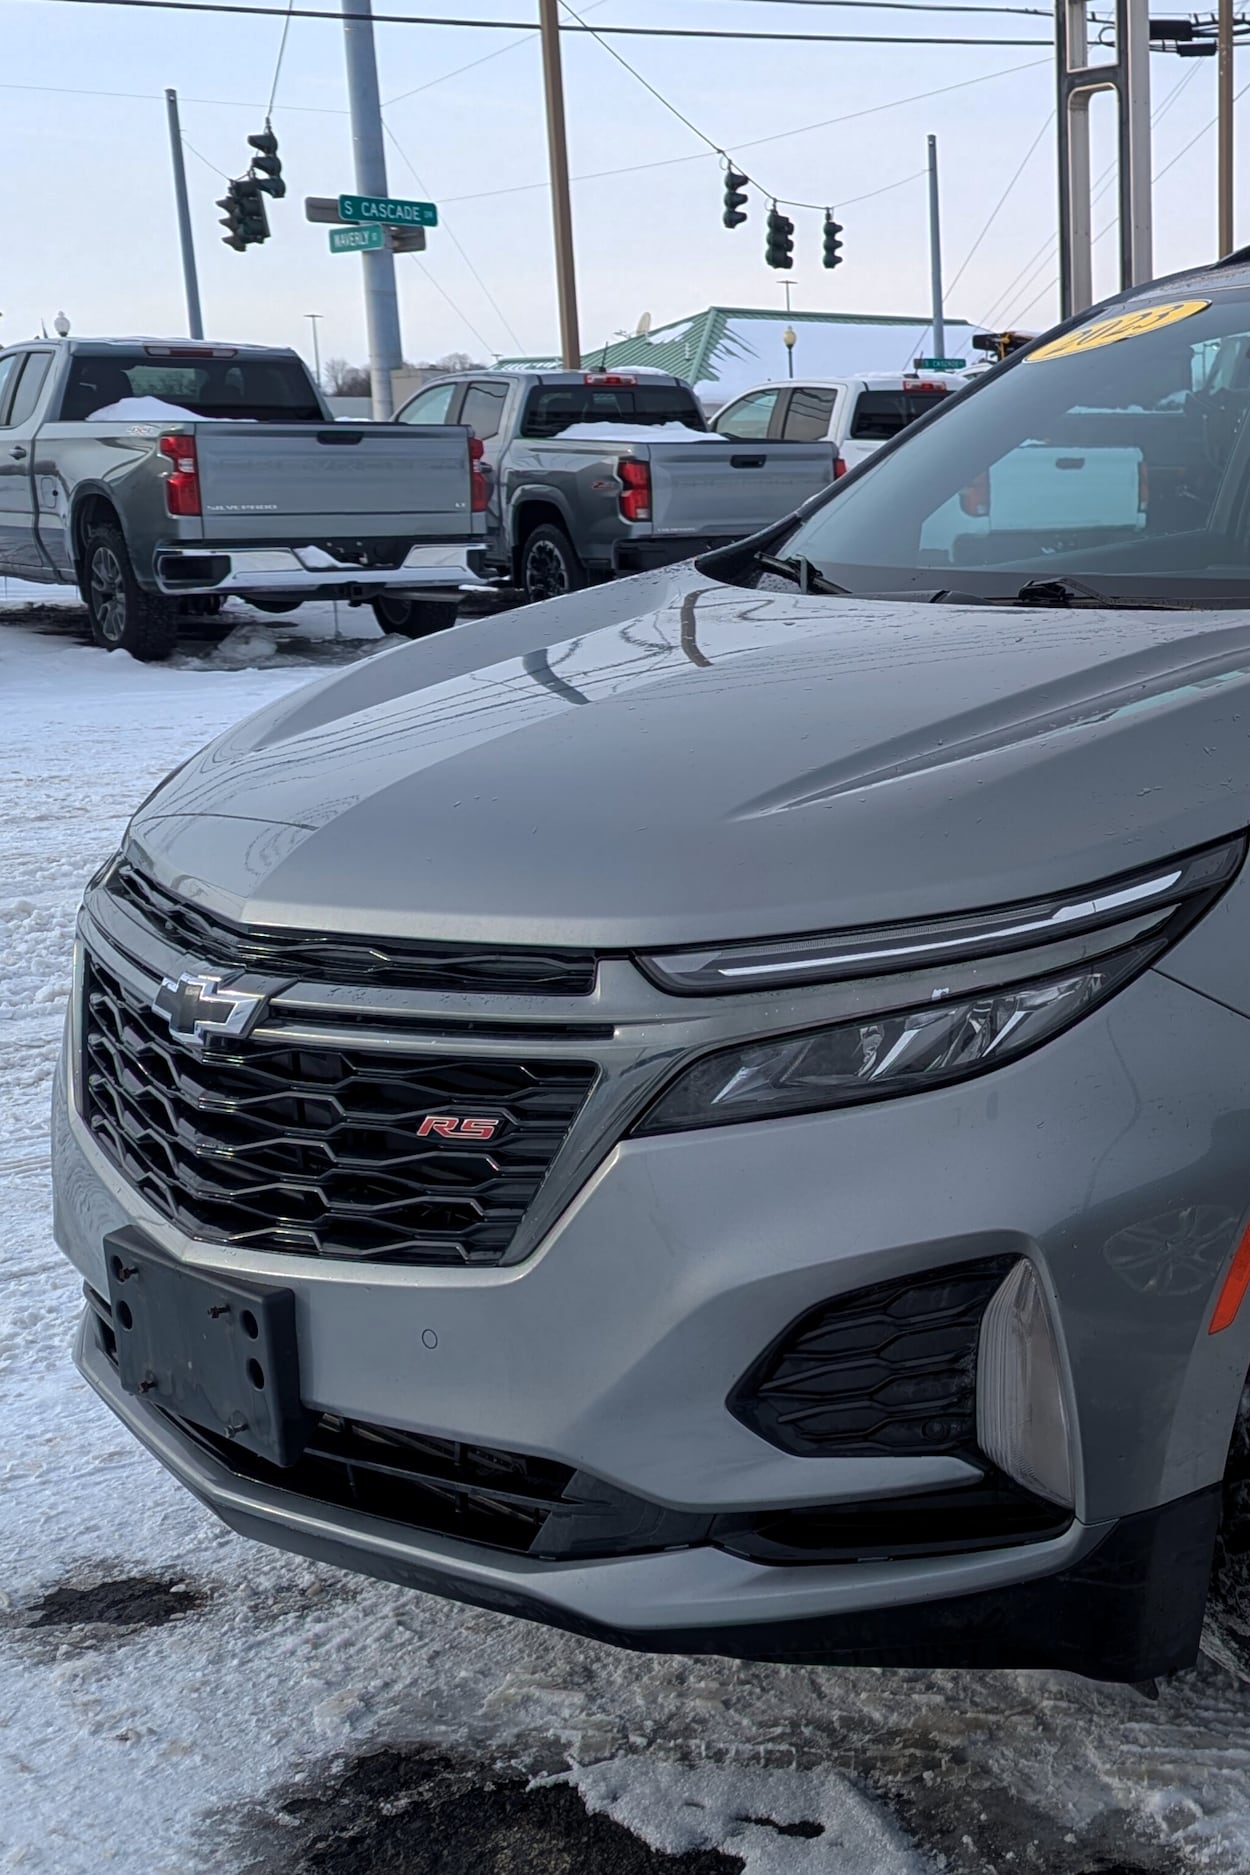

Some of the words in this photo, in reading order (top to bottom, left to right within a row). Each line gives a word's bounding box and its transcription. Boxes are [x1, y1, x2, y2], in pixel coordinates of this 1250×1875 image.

[344, 201, 353, 215] S
[361, 202, 421, 220] CASCADE
[334, 231, 369, 247] WAVERLY
[1042, 303, 1186, 357] 2023
[416, 1115, 499, 1140] RS
